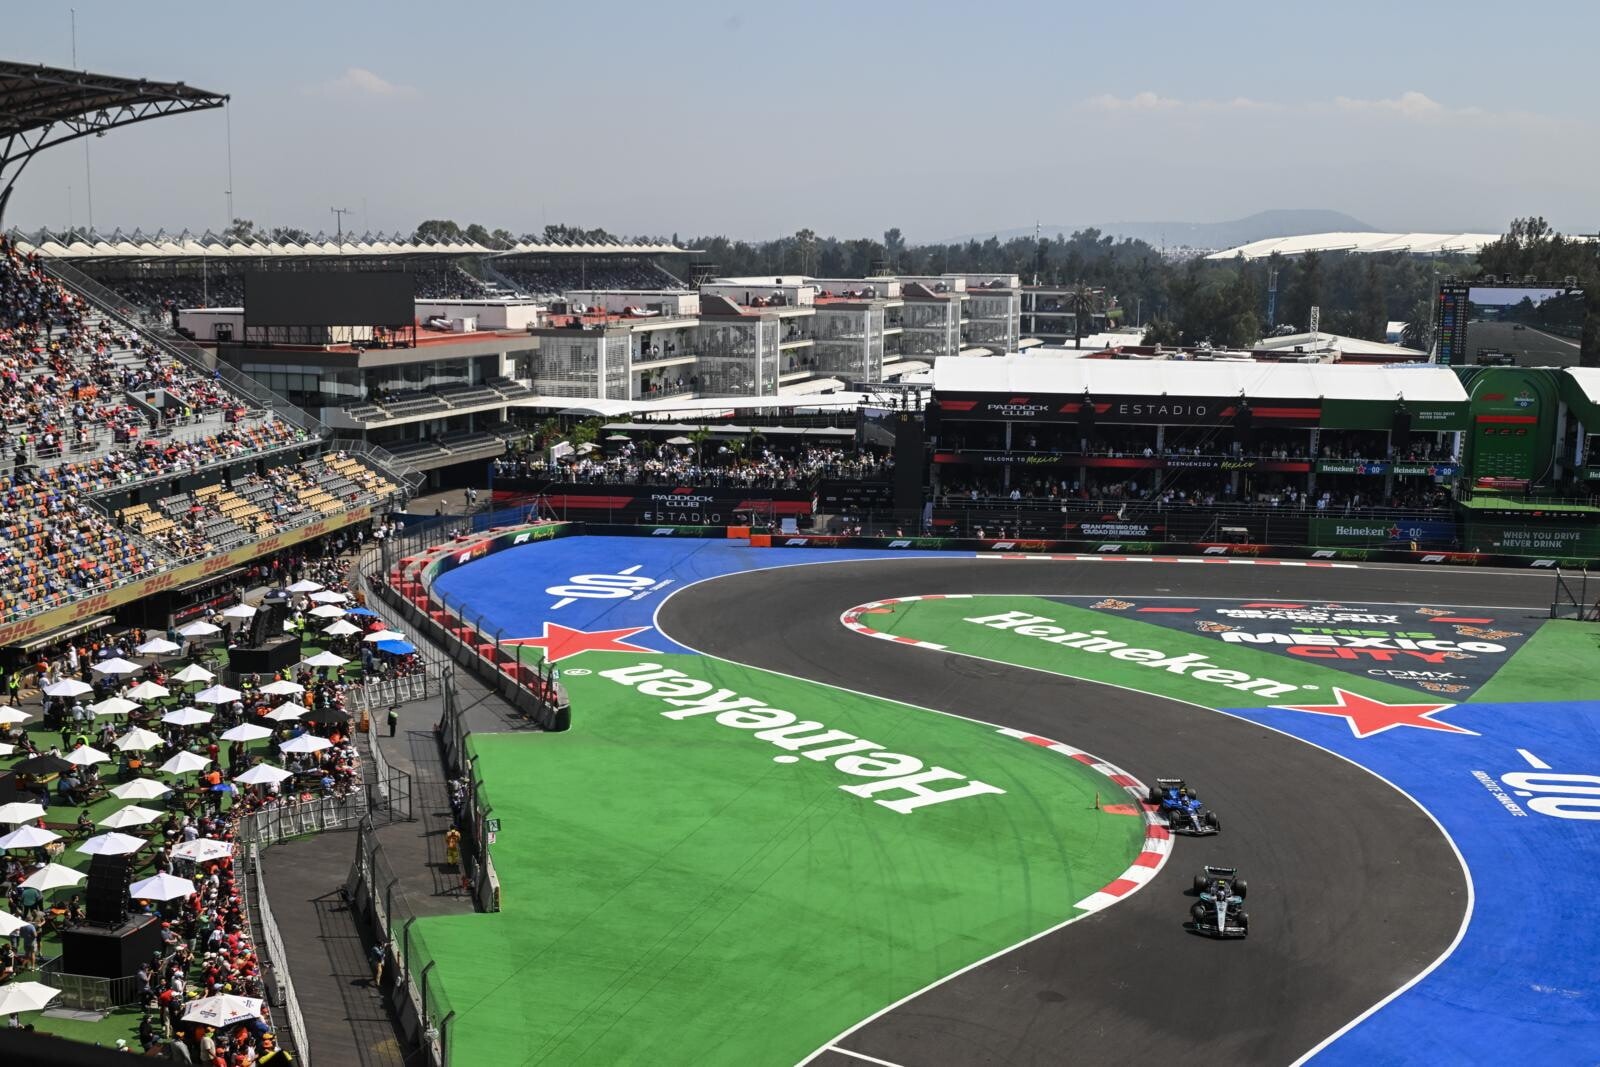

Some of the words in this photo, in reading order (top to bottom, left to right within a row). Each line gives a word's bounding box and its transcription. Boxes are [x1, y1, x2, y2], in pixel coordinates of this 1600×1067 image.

[1120, 404, 1206, 416] ESTADIO
[347, 508, 365, 522] DHL
[304, 522, 326, 537] DHL
[1336, 526, 1383, 536] Heineken
[1503, 531, 1530, 539] WHEN
[256, 538, 280, 553] DHL
[204, 555, 229, 572] DHL
[144, 574, 174, 592] DHL
[76, 596, 110, 617] DHL
[1216, 609, 1330, 618] MEXICO
[0, 620, 37, 642] DHL
[1292, 627, 1390, 637] THIS
[1220, 632, 1506, 652] MEXICO
[963, 611, 1298, 698] Heineken
[1286, 645, 1446, 663] CITY
[598, 662, 1007, 814] Heineken
